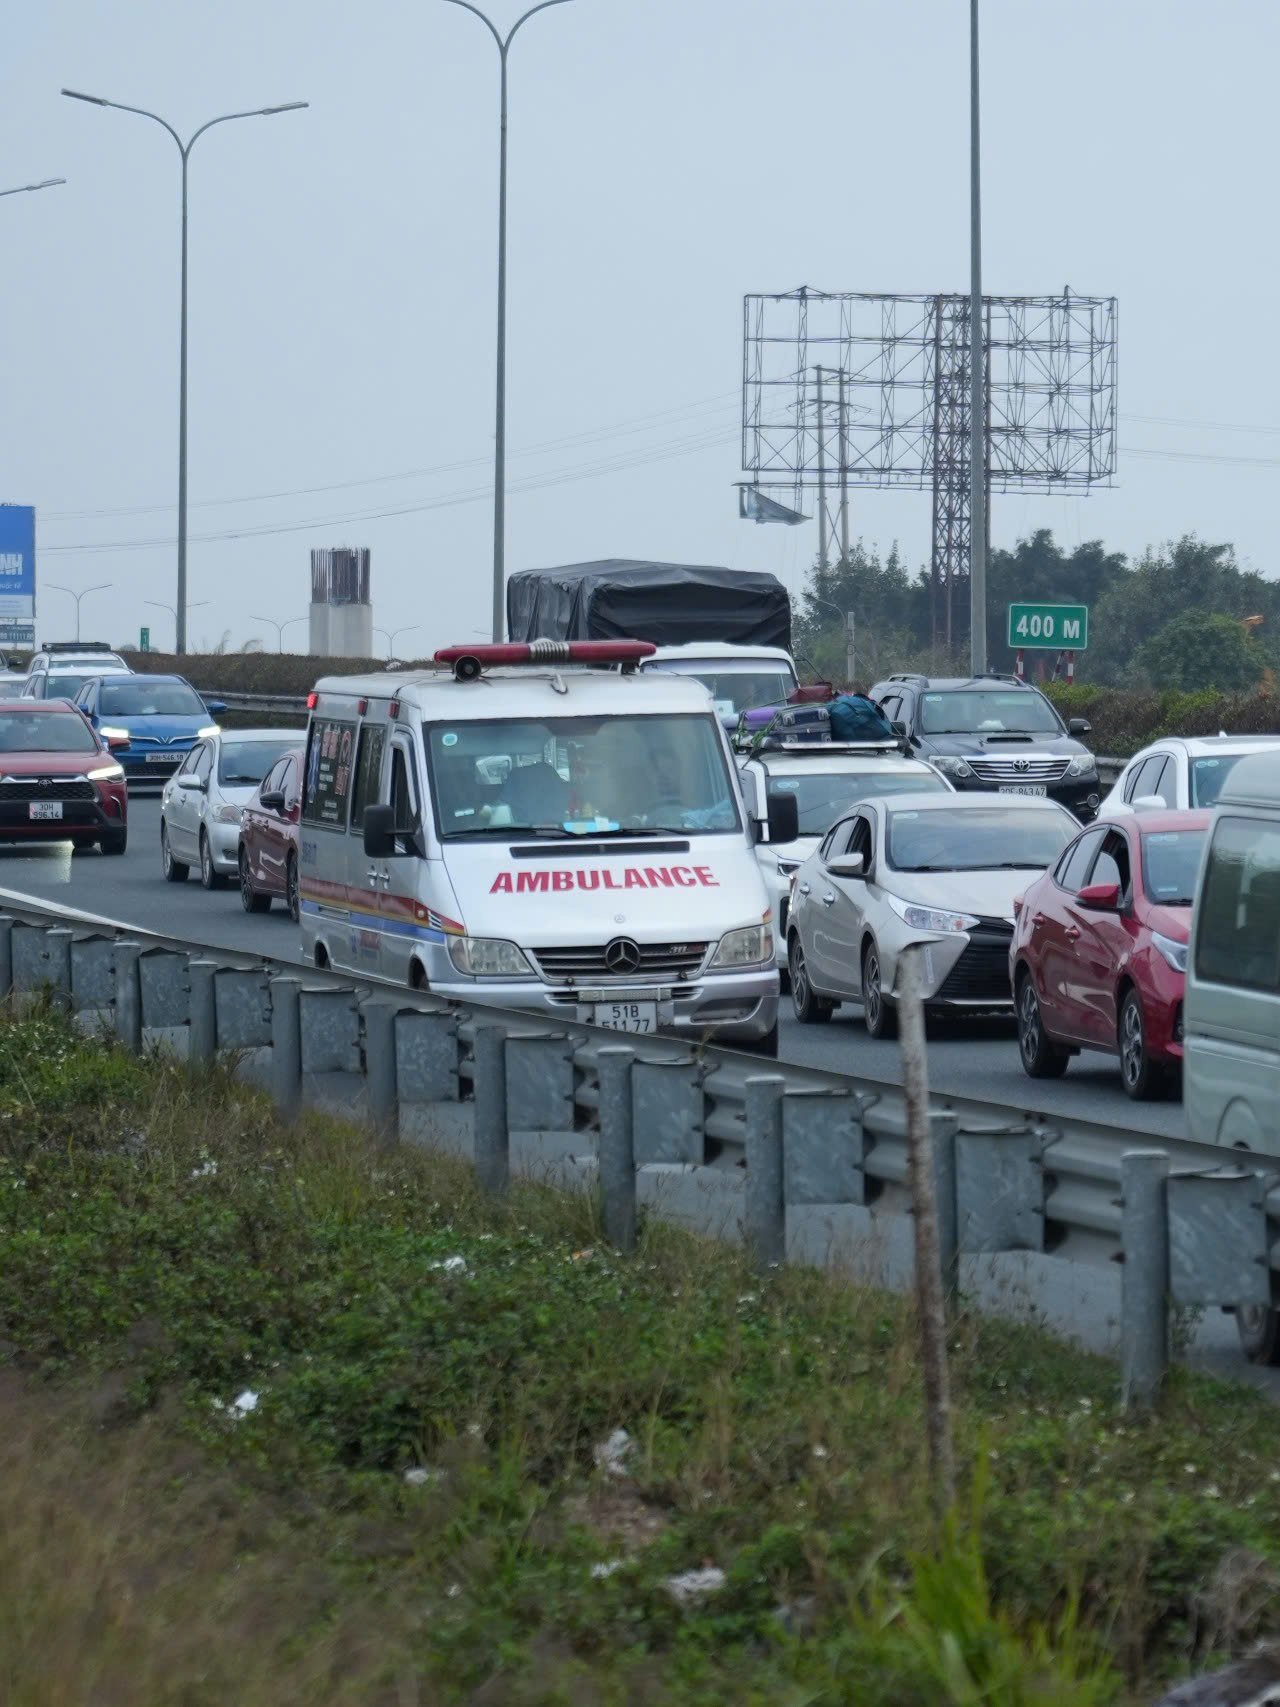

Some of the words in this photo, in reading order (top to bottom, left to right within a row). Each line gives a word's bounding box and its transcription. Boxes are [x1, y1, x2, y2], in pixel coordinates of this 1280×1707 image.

[1016, 615, 1054, 638] 400
[1063, 620, 1080, 638] M
[39, 803, 54, 811] 30H
[489, 866, 721, 894] AMBULANCE
[612, 1005, 639, 1019] 51B
